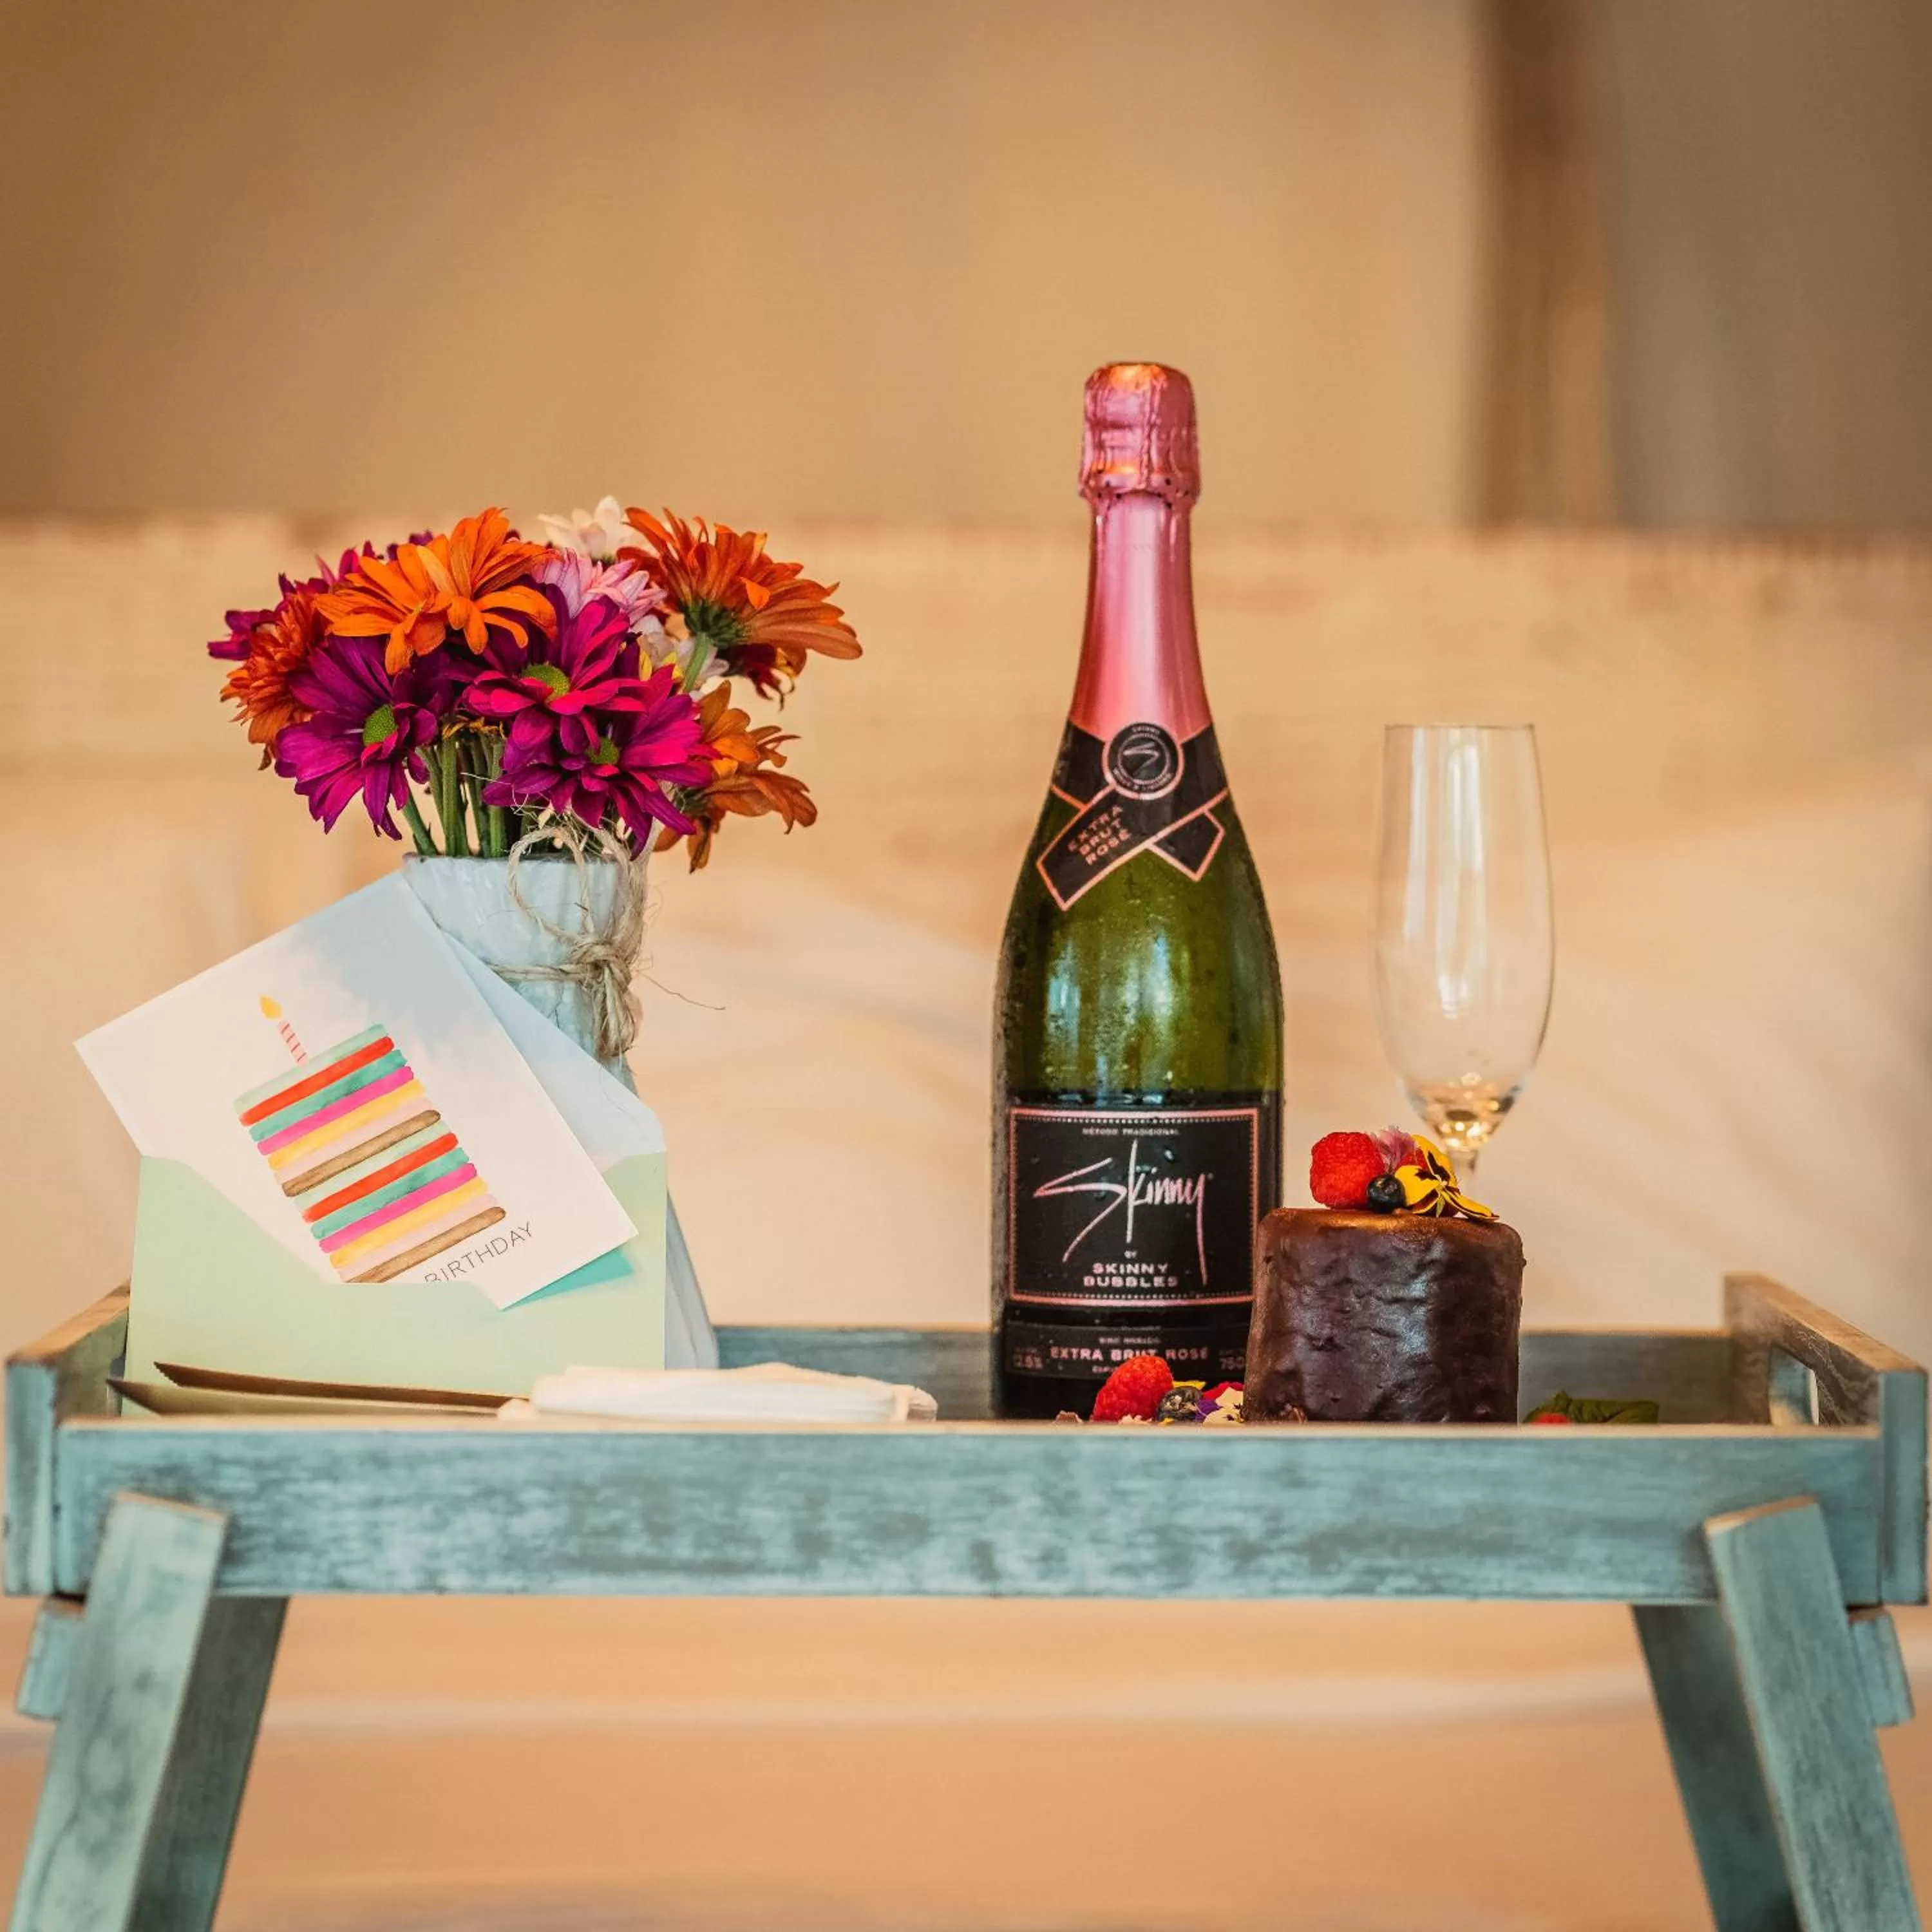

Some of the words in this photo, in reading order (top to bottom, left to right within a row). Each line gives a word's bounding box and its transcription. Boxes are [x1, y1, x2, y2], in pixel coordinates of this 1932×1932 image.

[1067, 804, 1124, 851] EXTRA
[1079, 819, 1121, 856] BRUT
[1034, 1139, 1208, 1285] Skinny
[1124, 1250, 1138, 1258] BY
[1092, 1262, 1168, 1274] SKINNY
[1083, 1275, 1178, 1287] BUBBLES
[1050, 1346, 1103, 1361] EXTRA
